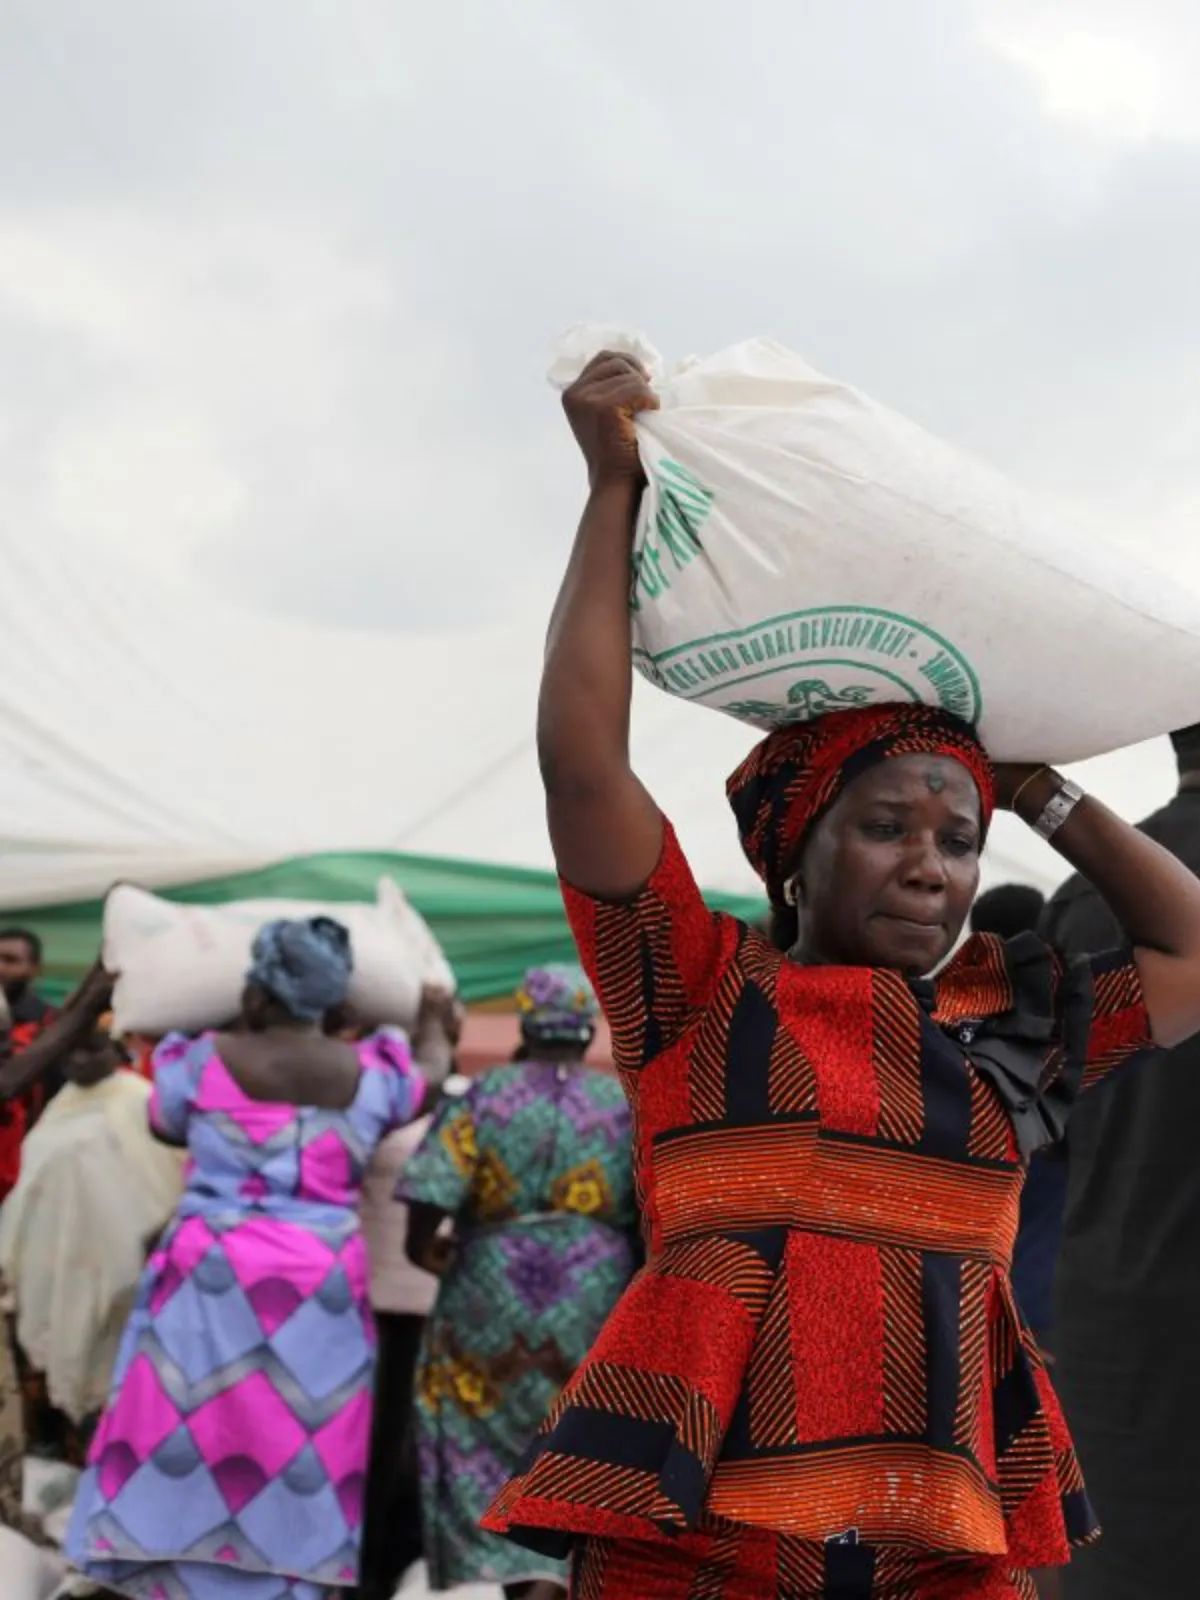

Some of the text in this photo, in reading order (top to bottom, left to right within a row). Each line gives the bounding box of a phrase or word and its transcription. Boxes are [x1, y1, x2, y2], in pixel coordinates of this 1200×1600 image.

[698, 646, 741, 677] AND
[736, 625, 796, 667] RURAL
[799, 616, 917, 659] DEVELOPMENT
